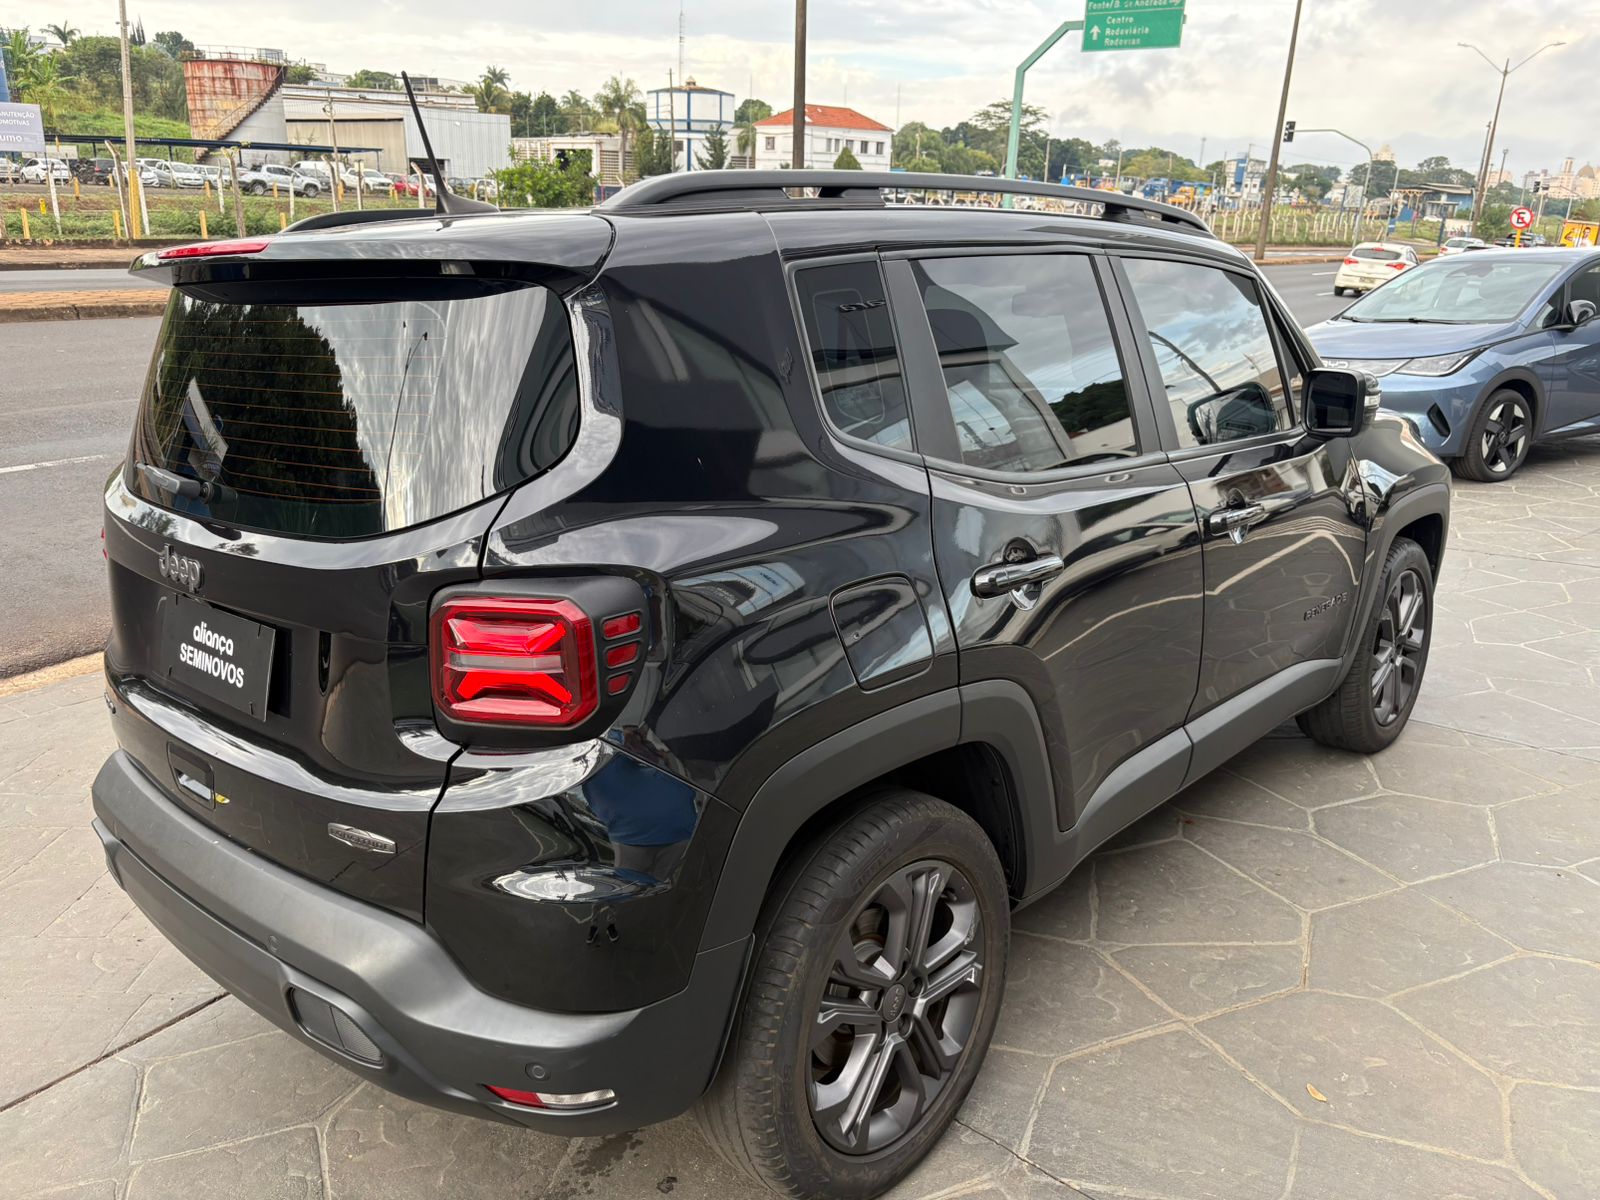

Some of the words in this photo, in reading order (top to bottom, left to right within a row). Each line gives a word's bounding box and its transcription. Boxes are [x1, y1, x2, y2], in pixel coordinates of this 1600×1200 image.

[1104, 26, 1150, 37] Rodoviária
[1106, 16, 1134, 25] Centro
[1104, 38, 1141, 47] Rodovias
[159, 543, 203, 594] Jeep
[193, 621, 234, 656] aliança
[179, 642, 245, 688] SEMINOVOS
